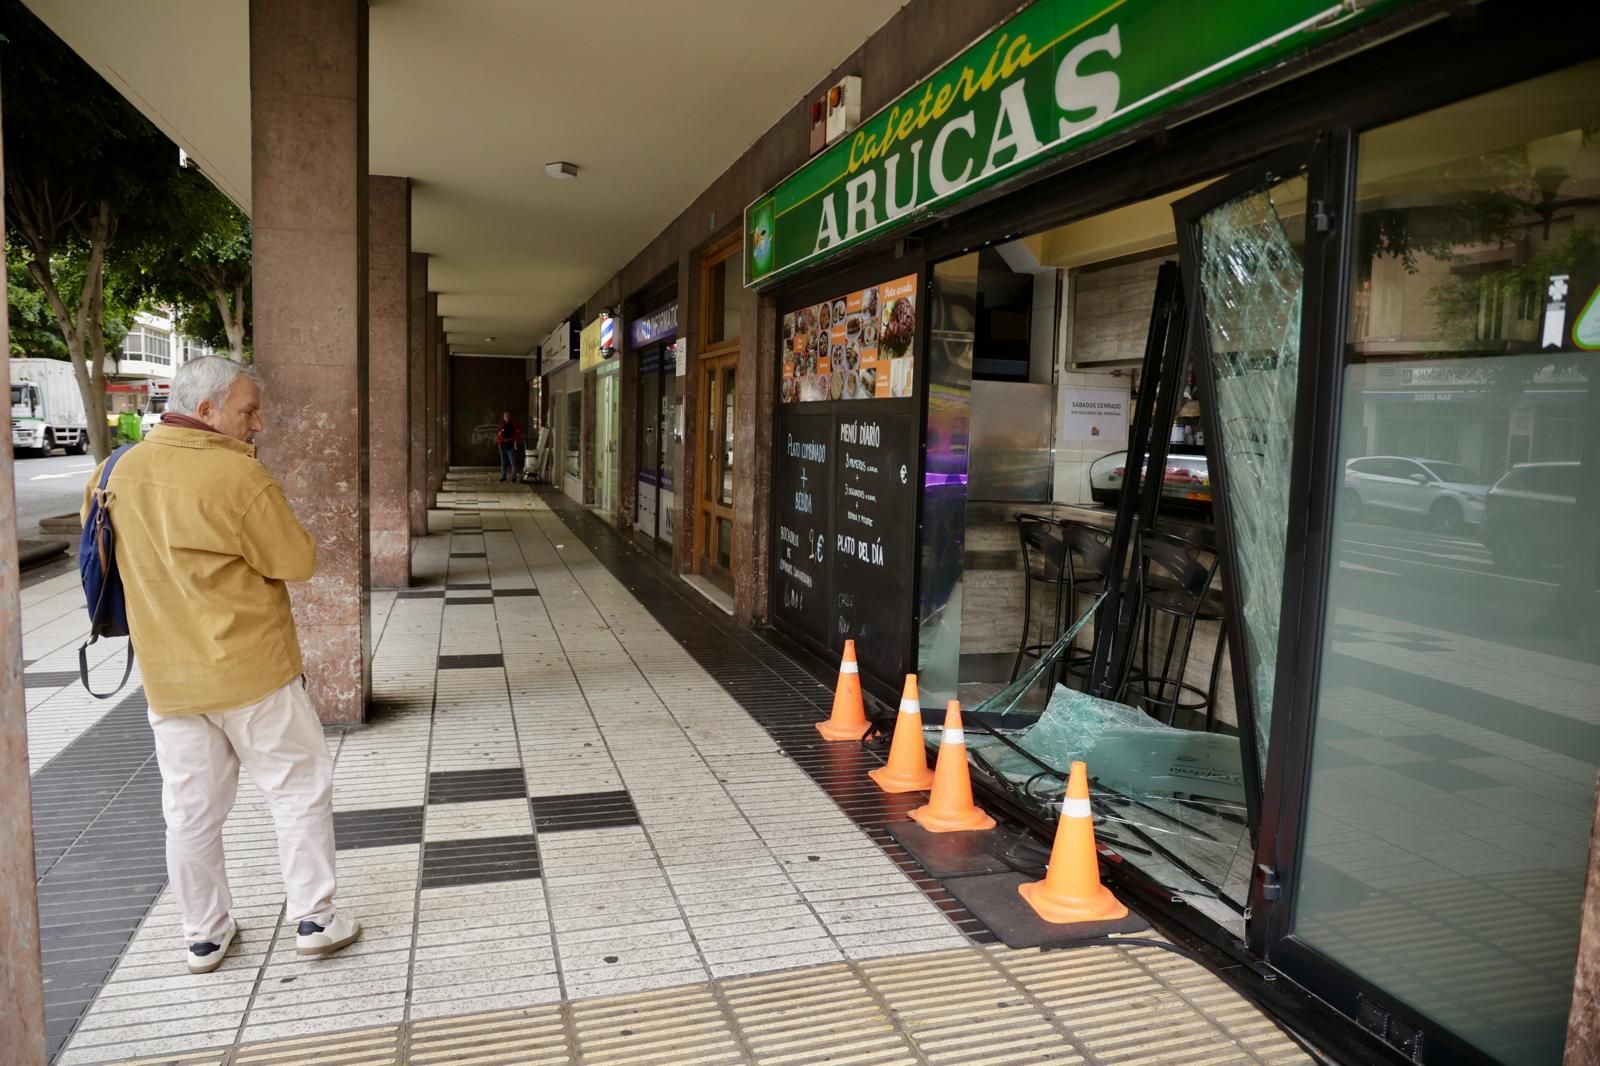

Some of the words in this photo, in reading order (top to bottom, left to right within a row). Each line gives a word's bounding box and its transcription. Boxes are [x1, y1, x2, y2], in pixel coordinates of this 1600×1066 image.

[847, 33, 1035, 173] Cafetería
[812, 24, 1121, 254] ARUCAS
[1097, 402, 1122, 410] CERRADO
[840, 420, 858, 445] MENÚ
[900, 464, 907, 484] €
[837, 533, 856, 556] PLATO
[858, 541, 870, 563] DEL
[871, 536, 884, 567] DÍA
